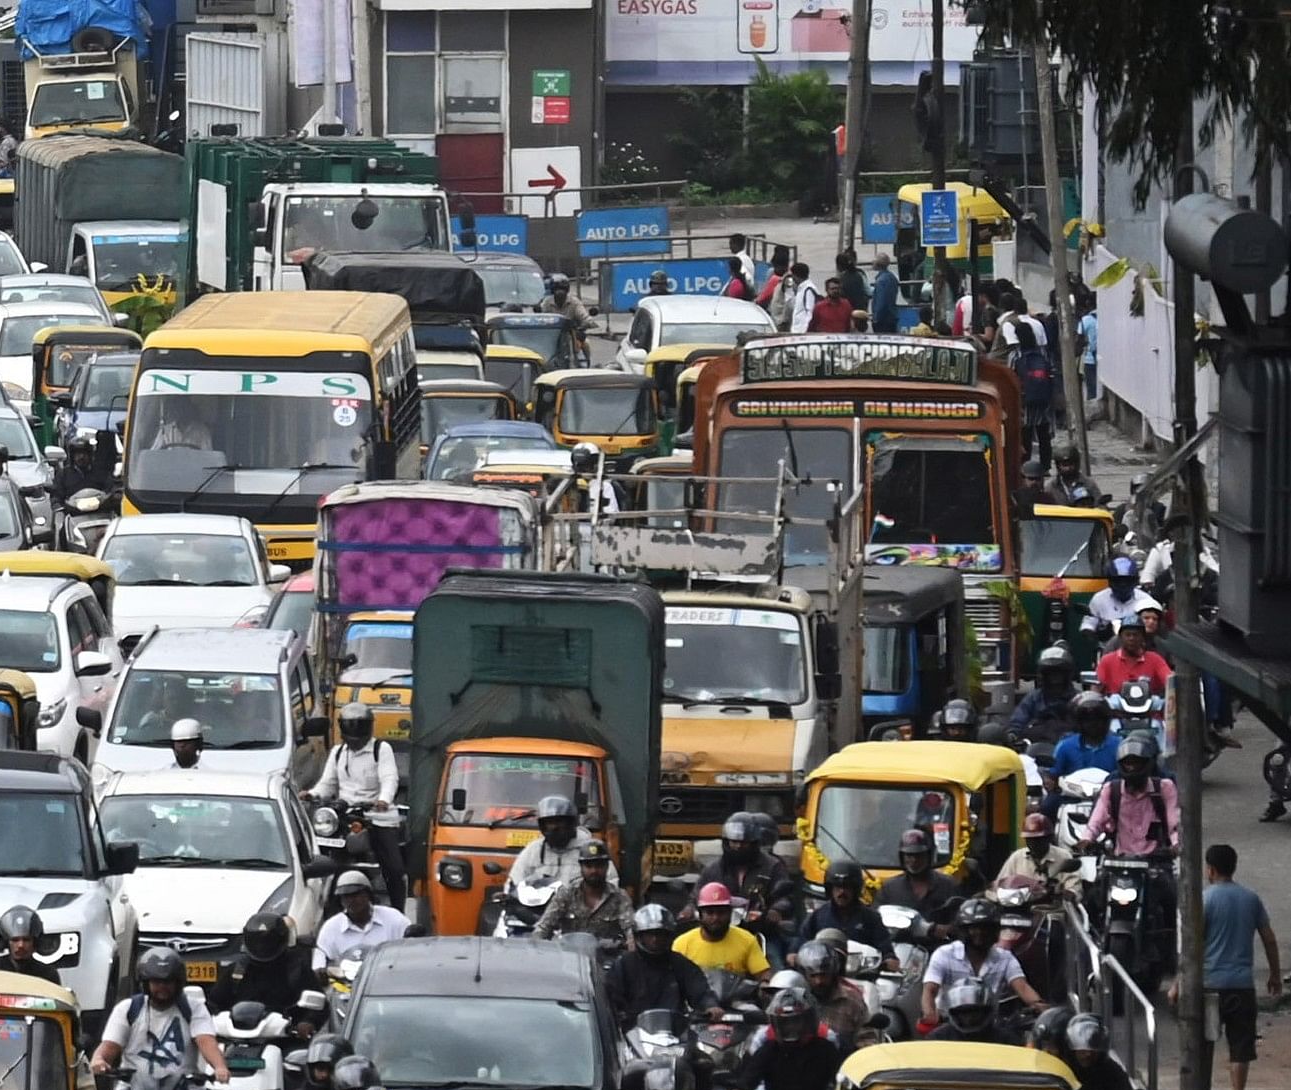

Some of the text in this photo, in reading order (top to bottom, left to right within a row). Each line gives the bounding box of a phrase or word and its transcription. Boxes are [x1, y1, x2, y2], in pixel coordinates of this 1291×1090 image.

[617, 0, 698, 14] EASYGAS
[492, 234, 520, 246] LPG
[585, 224, 660, 240] AUTO LPG
[622, 275, 721, 295] AUO LPG
[767, 401, 854, 415] VINAYAKA
[891, 403, 979, 418] MURUGA
